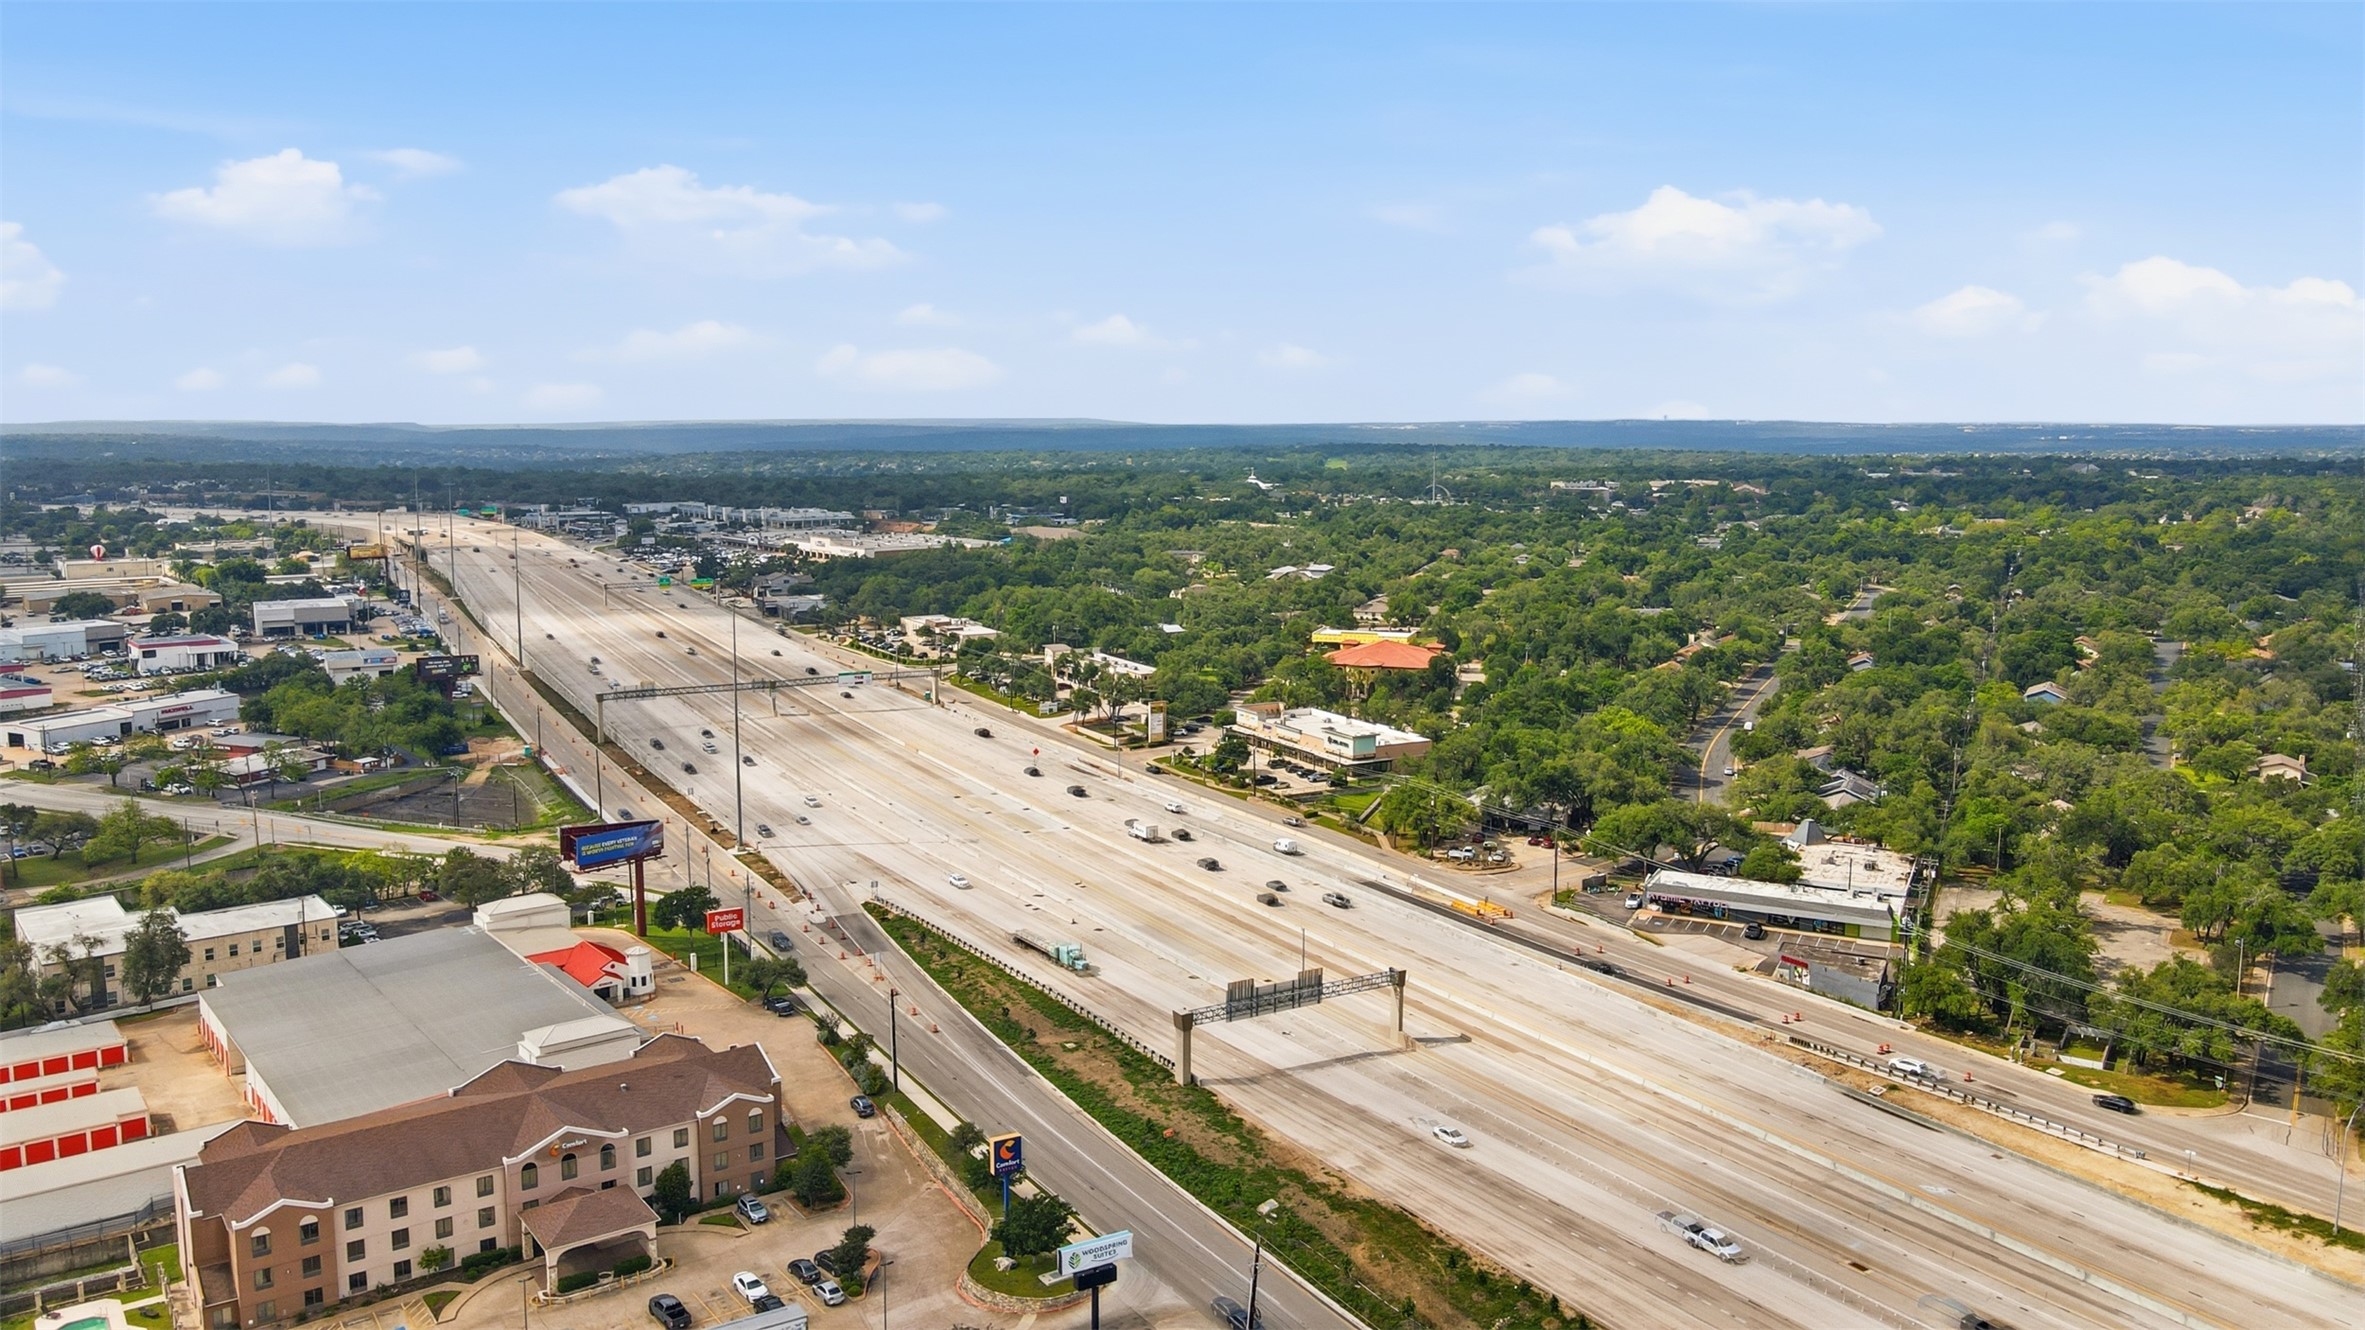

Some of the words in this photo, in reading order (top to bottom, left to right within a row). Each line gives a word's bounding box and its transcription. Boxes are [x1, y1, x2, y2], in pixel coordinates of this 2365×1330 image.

[1690, 898, 1729, 908] TATTOO
[714, 913, 738, 922] Public
[711, 919, 741, 929] Storage
[561, 1138, 588, 1149] Comfort
[996, 1158, 1020, 1169] Comfort
[1081, 1239, 1128, 1256] WOODSPRING
[1093, 1249, 1117, 1259] SUITES
